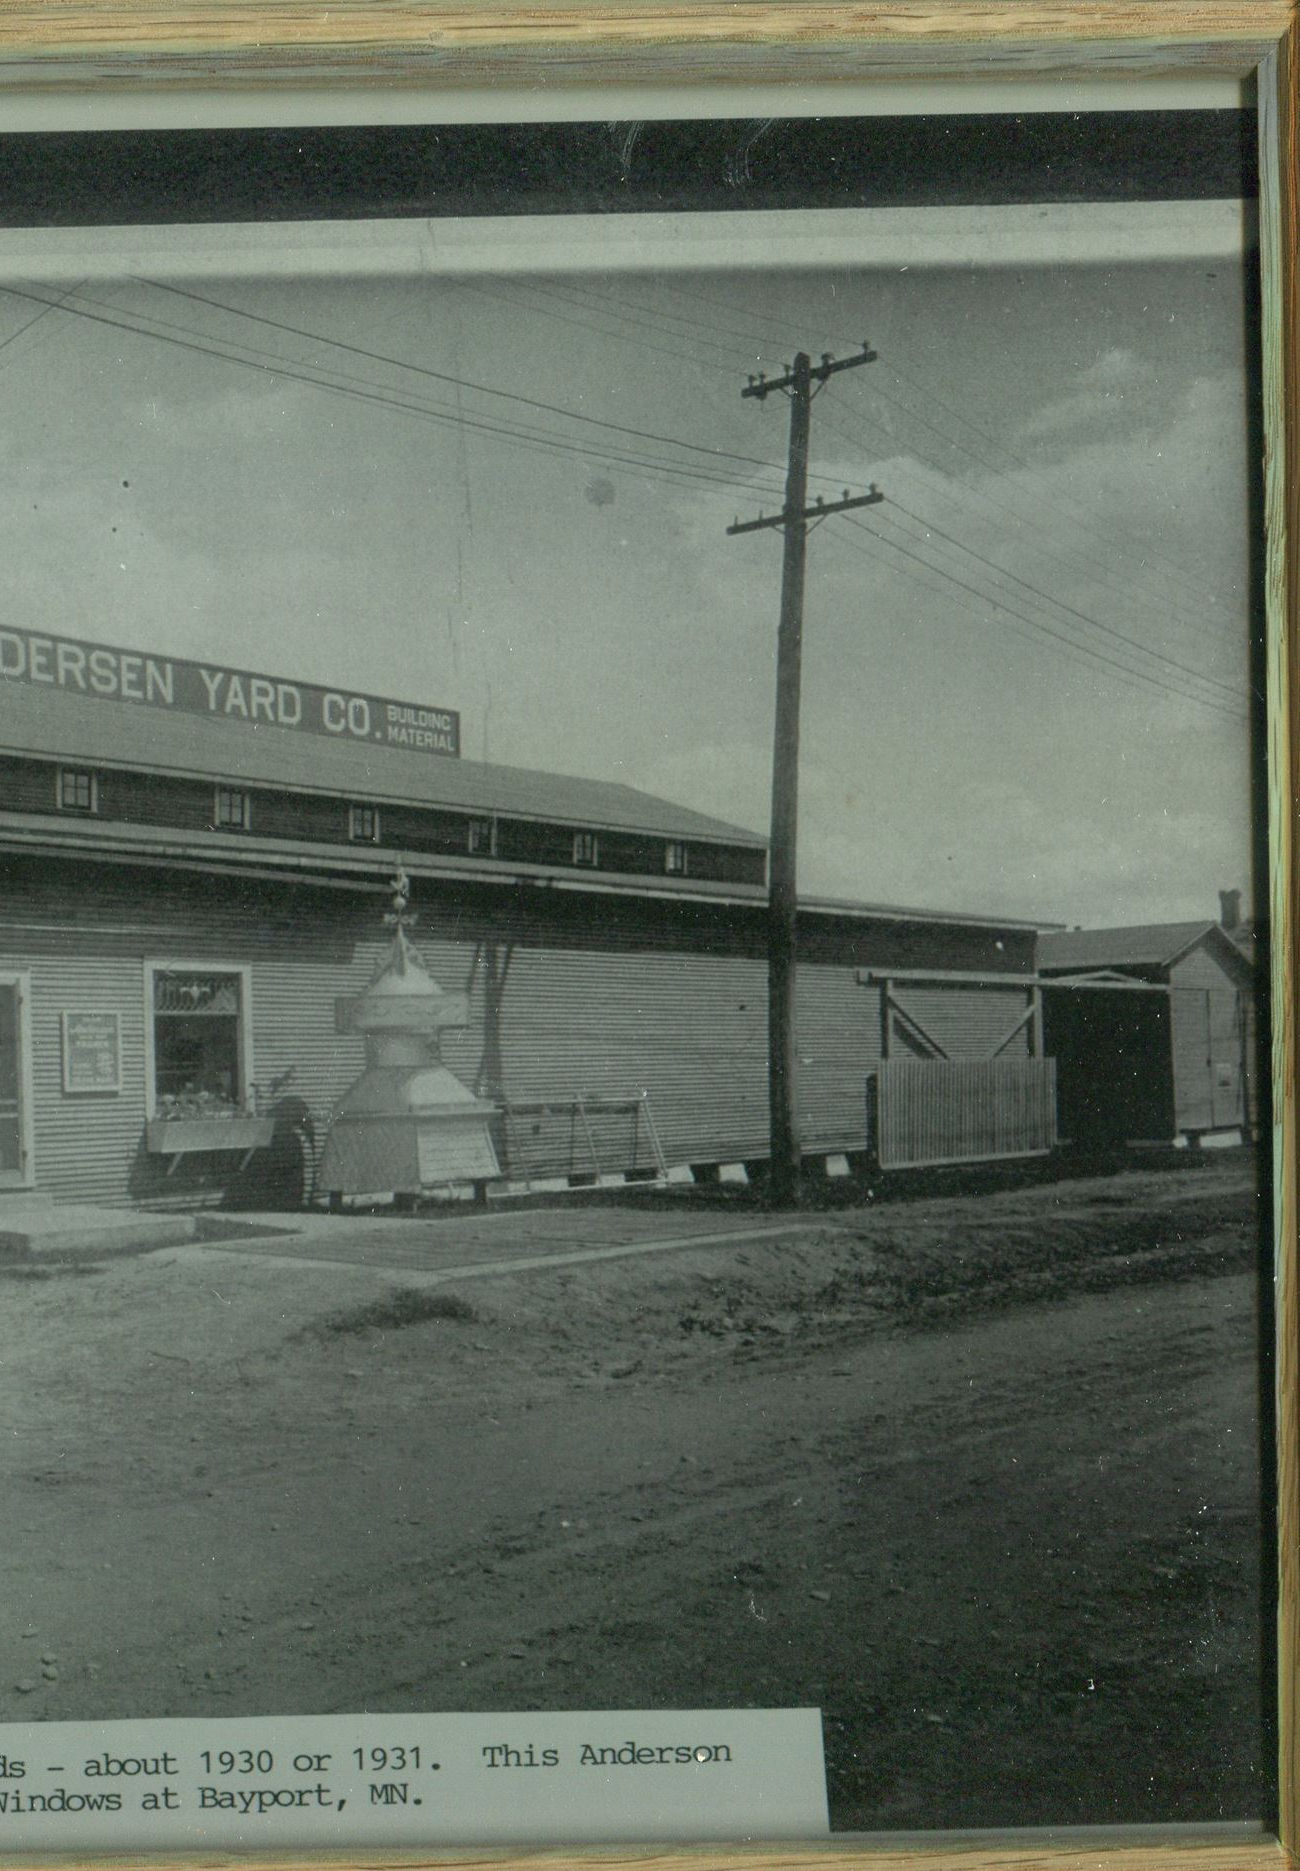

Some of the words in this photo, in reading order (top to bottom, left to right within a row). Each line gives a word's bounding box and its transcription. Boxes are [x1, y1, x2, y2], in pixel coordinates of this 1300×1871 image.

[199, 669, 302, 726] YARD
[322, 692, 382, 739] CO.
[387, 704, 452, 731] BUILDING
[387, 725, 455, 752] MATERIAL
